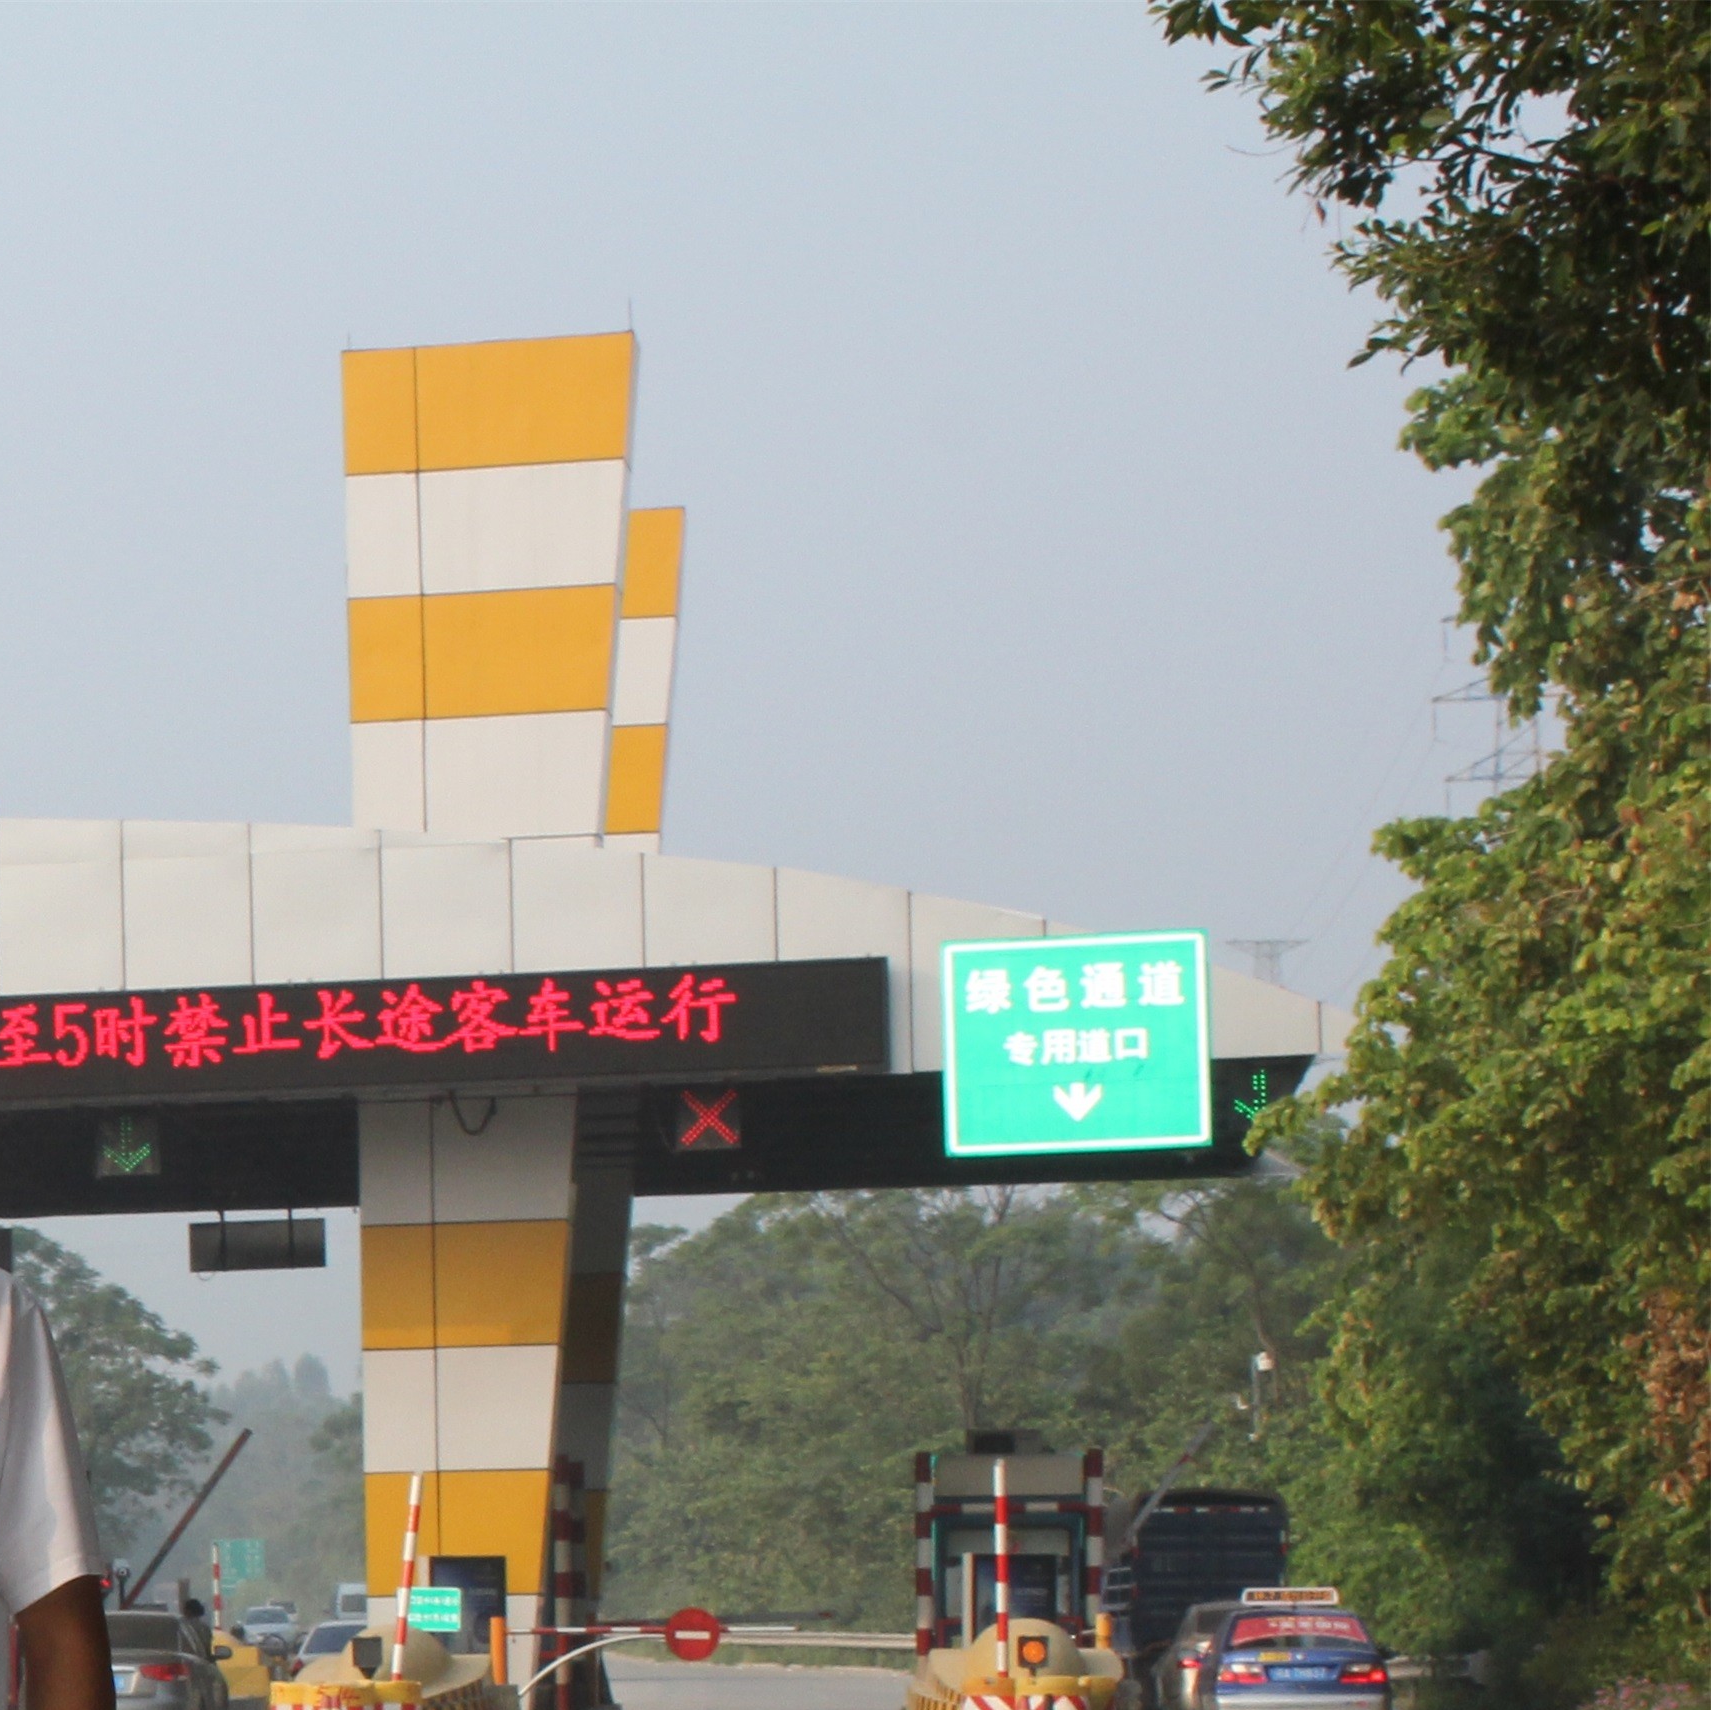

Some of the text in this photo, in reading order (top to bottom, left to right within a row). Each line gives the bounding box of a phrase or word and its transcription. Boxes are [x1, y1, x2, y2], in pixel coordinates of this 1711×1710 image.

[965, 960, 1186, 1014] 绿色通道
[1003, 1027, 1149, 1066] 专用道口
